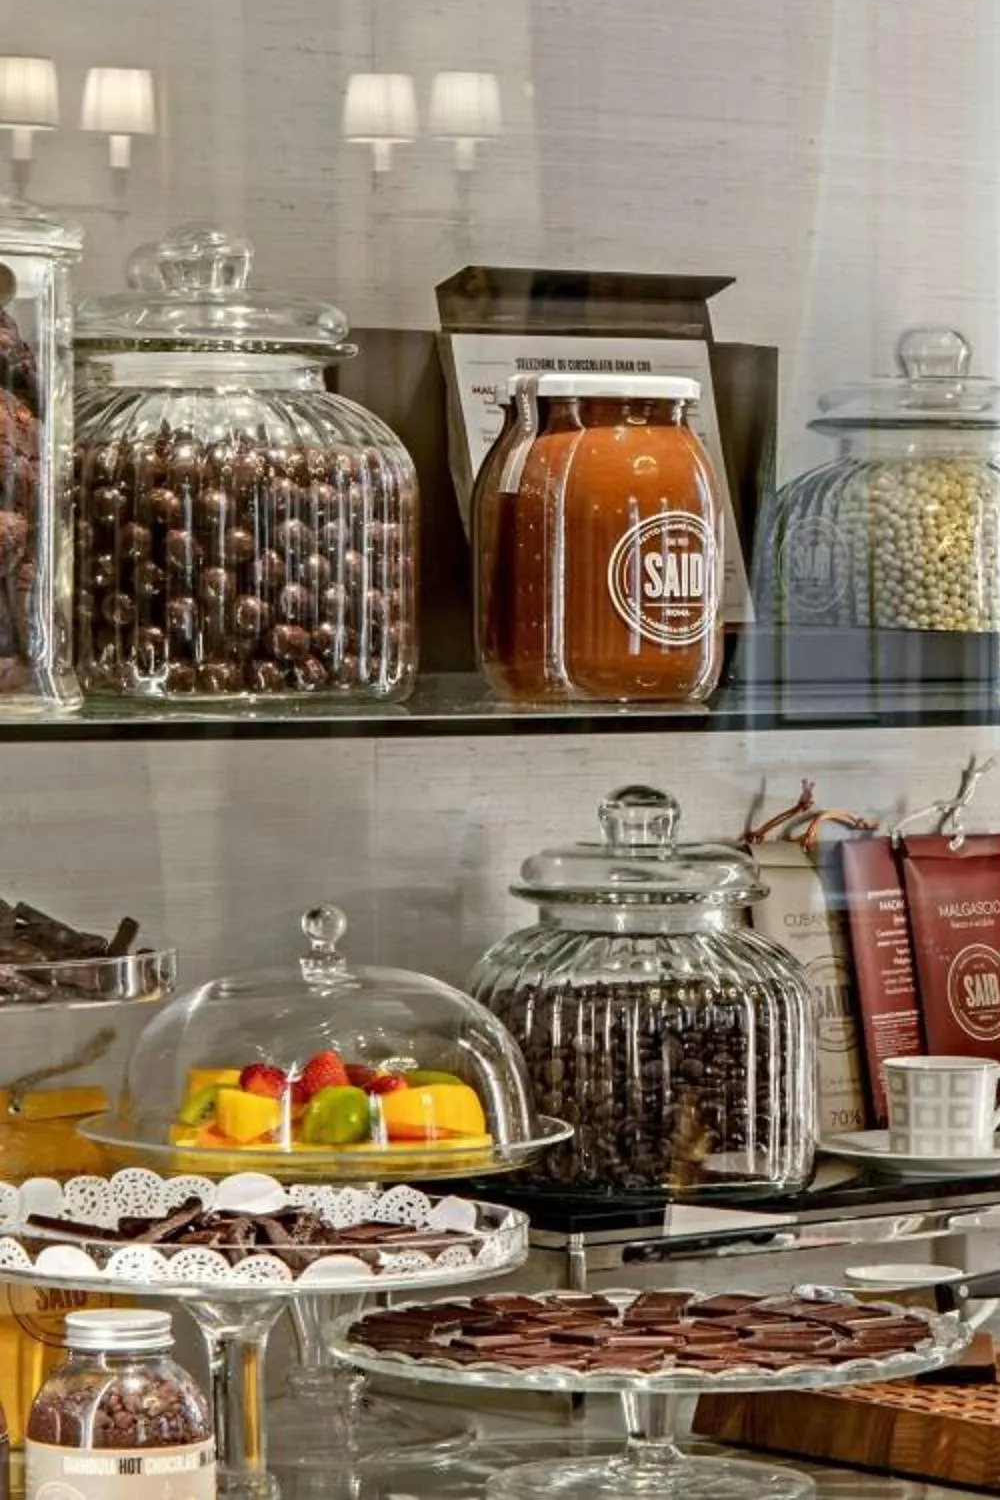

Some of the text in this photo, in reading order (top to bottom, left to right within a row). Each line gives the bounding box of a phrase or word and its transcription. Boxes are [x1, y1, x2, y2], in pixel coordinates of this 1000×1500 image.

[643, 551, 704, 598] SAID
[963, 972, 1000, 1008] SAID
[831, 1107, 863, 1127] 70%
[119, 1457, 143, 1475] HOT
